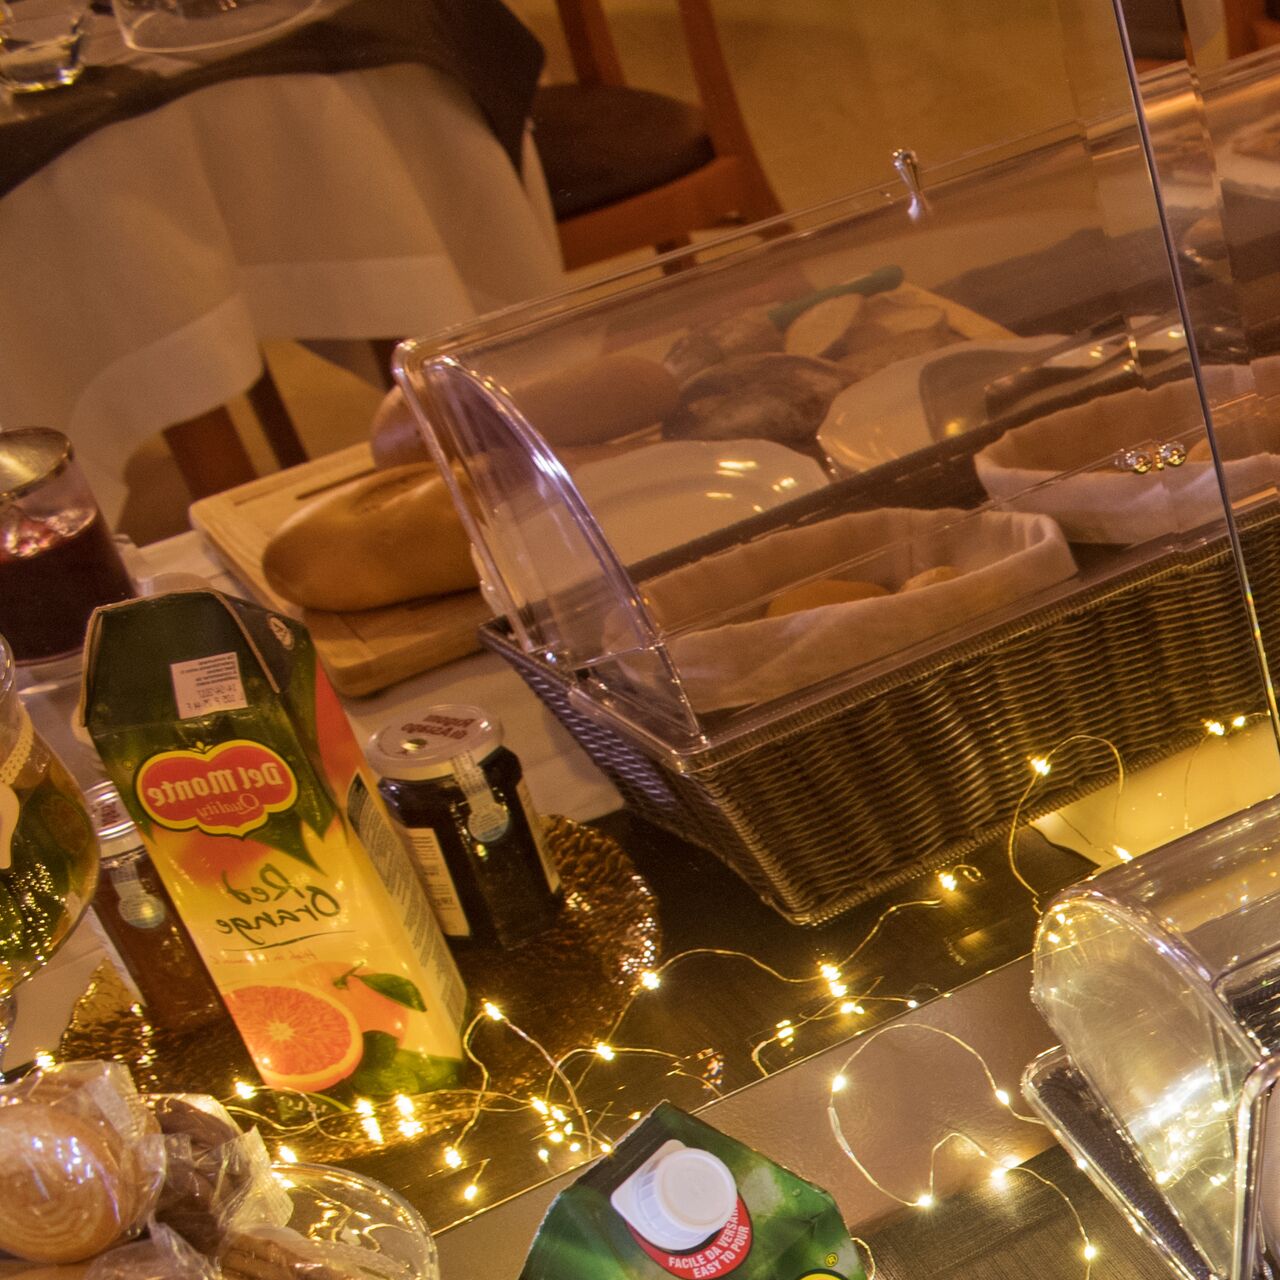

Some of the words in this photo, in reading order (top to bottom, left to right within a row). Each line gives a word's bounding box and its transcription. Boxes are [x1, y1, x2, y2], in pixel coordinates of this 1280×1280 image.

[668, 1254, 707, 1268] FACILE
[705, 1246, 722, 1260] DA
[692, 1259, 722, 1278] EASY
[719, 1250, 736, 1264] TO
[730, 1225, 750, 1252] POUR
